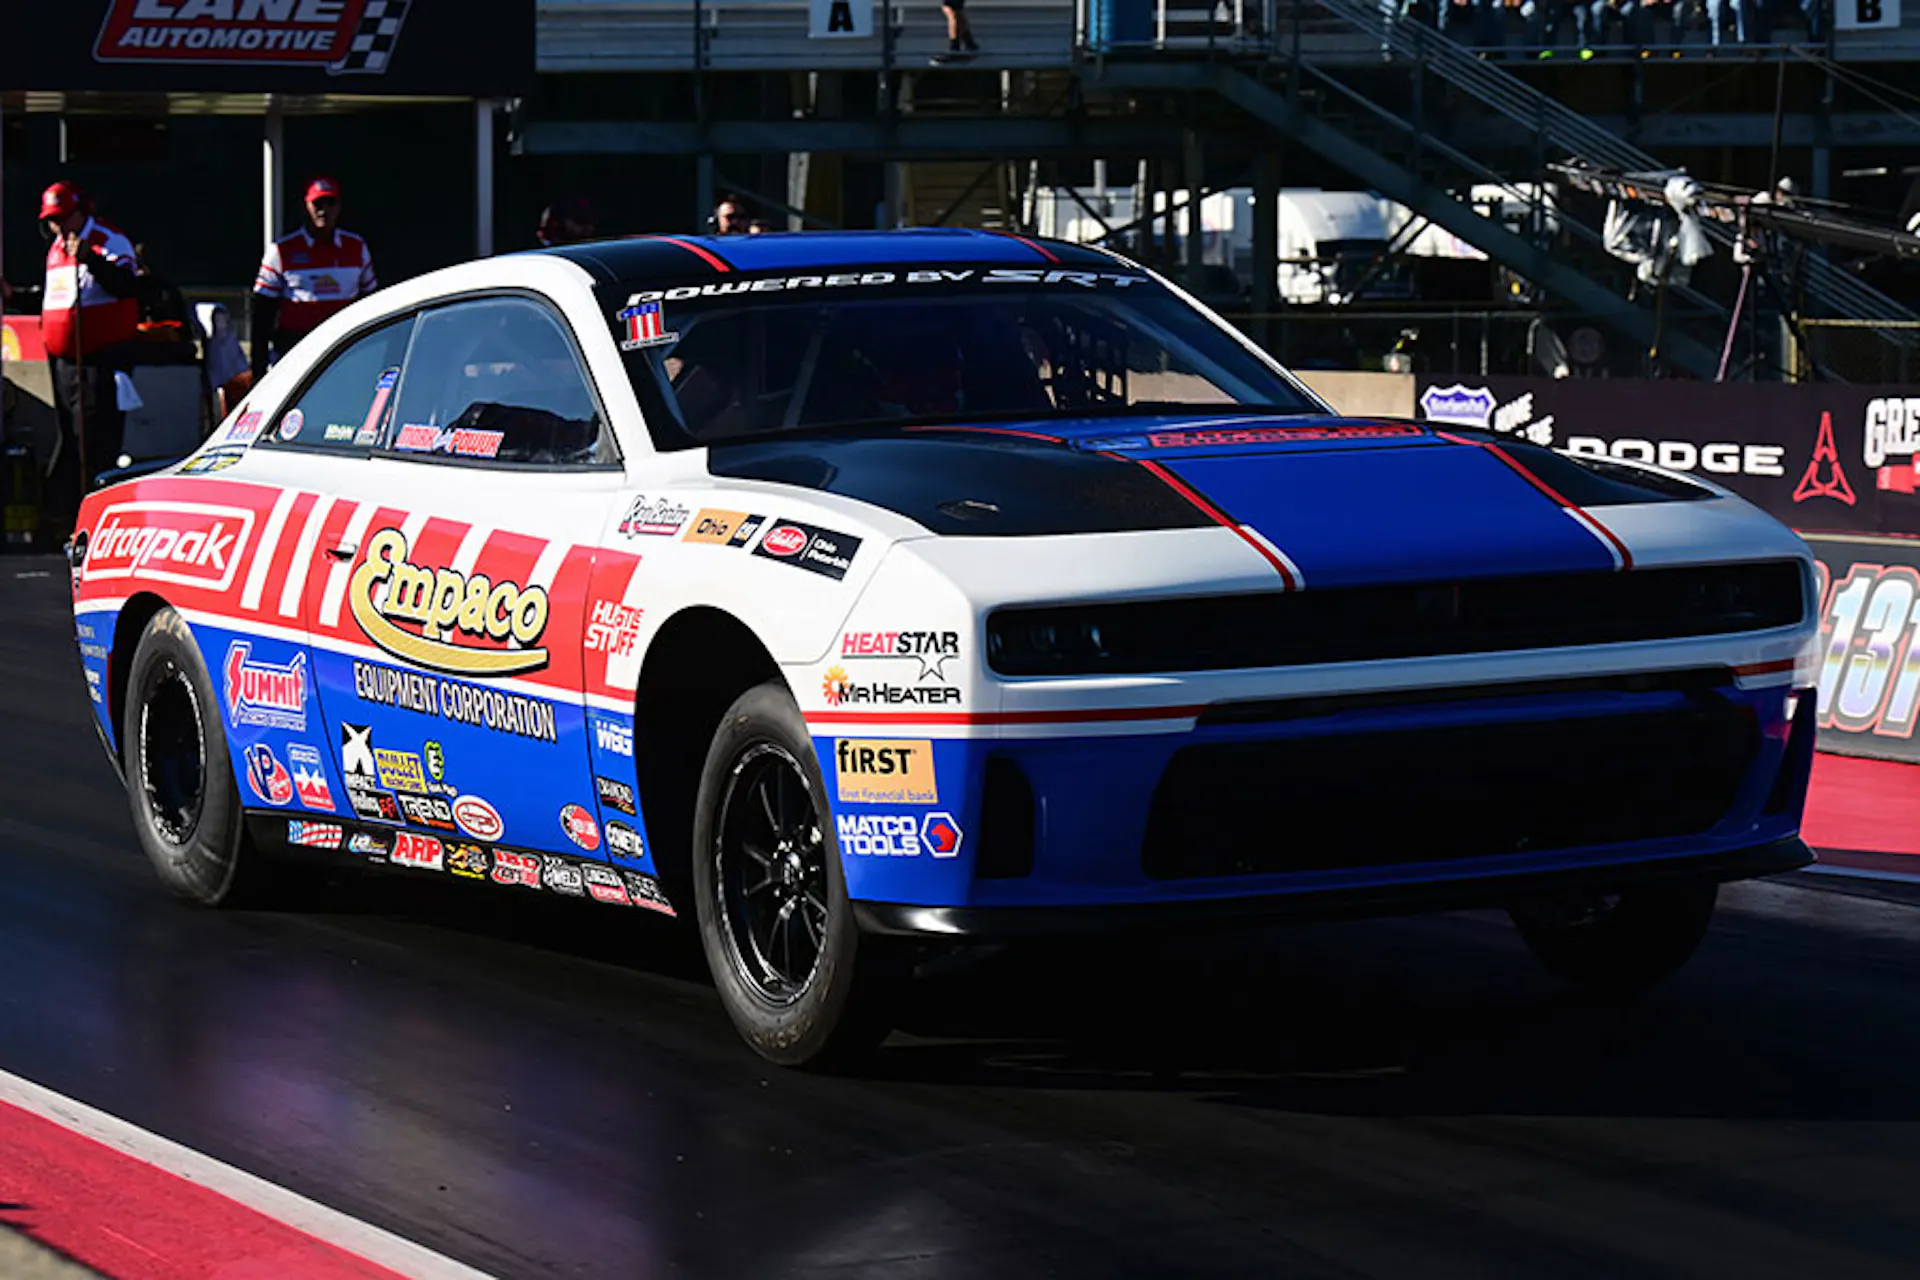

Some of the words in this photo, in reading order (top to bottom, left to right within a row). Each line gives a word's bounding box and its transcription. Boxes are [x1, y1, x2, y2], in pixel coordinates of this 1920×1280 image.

[133, 0, 345, 23] LANE
[828, 2, 854, 32] A
[1856, 0, 1882, 23] B
[118, 26, 337, 50] AUTOMOTIVE
[626, 271, 896, 306] POWERED
[906, 269, 974, 284] BY
[981, 268, 1150, 289] SRT
[1568, 437, 1784, 476] DODGE
[697, 517, 728, 536] Ohio
[91, 518, 234, 575] dragpak
[814, 538, 838, 553] Ohio
[350, 528, 549, 652] Empaco
[841, 631, 959, 654] HEATSTAR
[354, 660, 439, 717] EQUIPMENT
[440, 680, 558, 744] CORPORATION
[861, 787, 905, 801] financial
[908, 788, 934, 801] bank
[837, 814, 918, 836] MATCO
[391, 833, 442, 863] ARP
[840, 835, 921, 857] TOOLS
